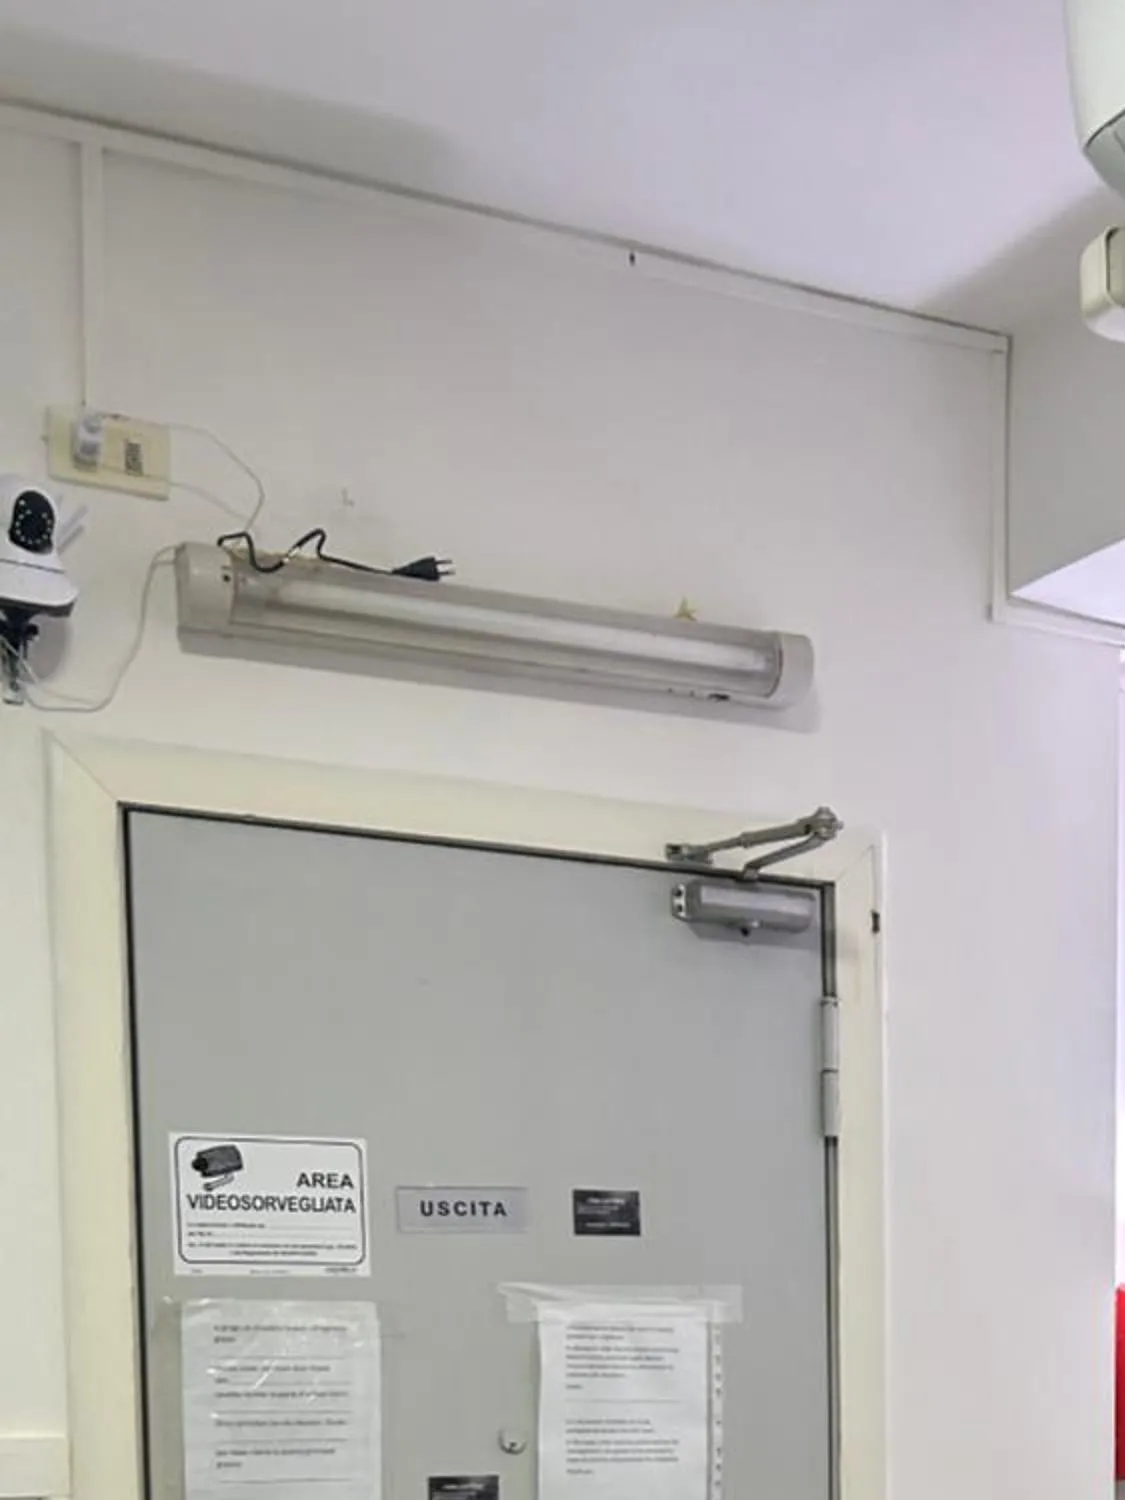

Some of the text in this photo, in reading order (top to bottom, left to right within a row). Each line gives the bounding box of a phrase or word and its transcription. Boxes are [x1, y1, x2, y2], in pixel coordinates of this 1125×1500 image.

[296, 1172, 354, 1189] AREA
[186, 1193, 356, 1213] VIDEOSORVEGLIATA
[420, 1200, 507, 1217] USCITA
